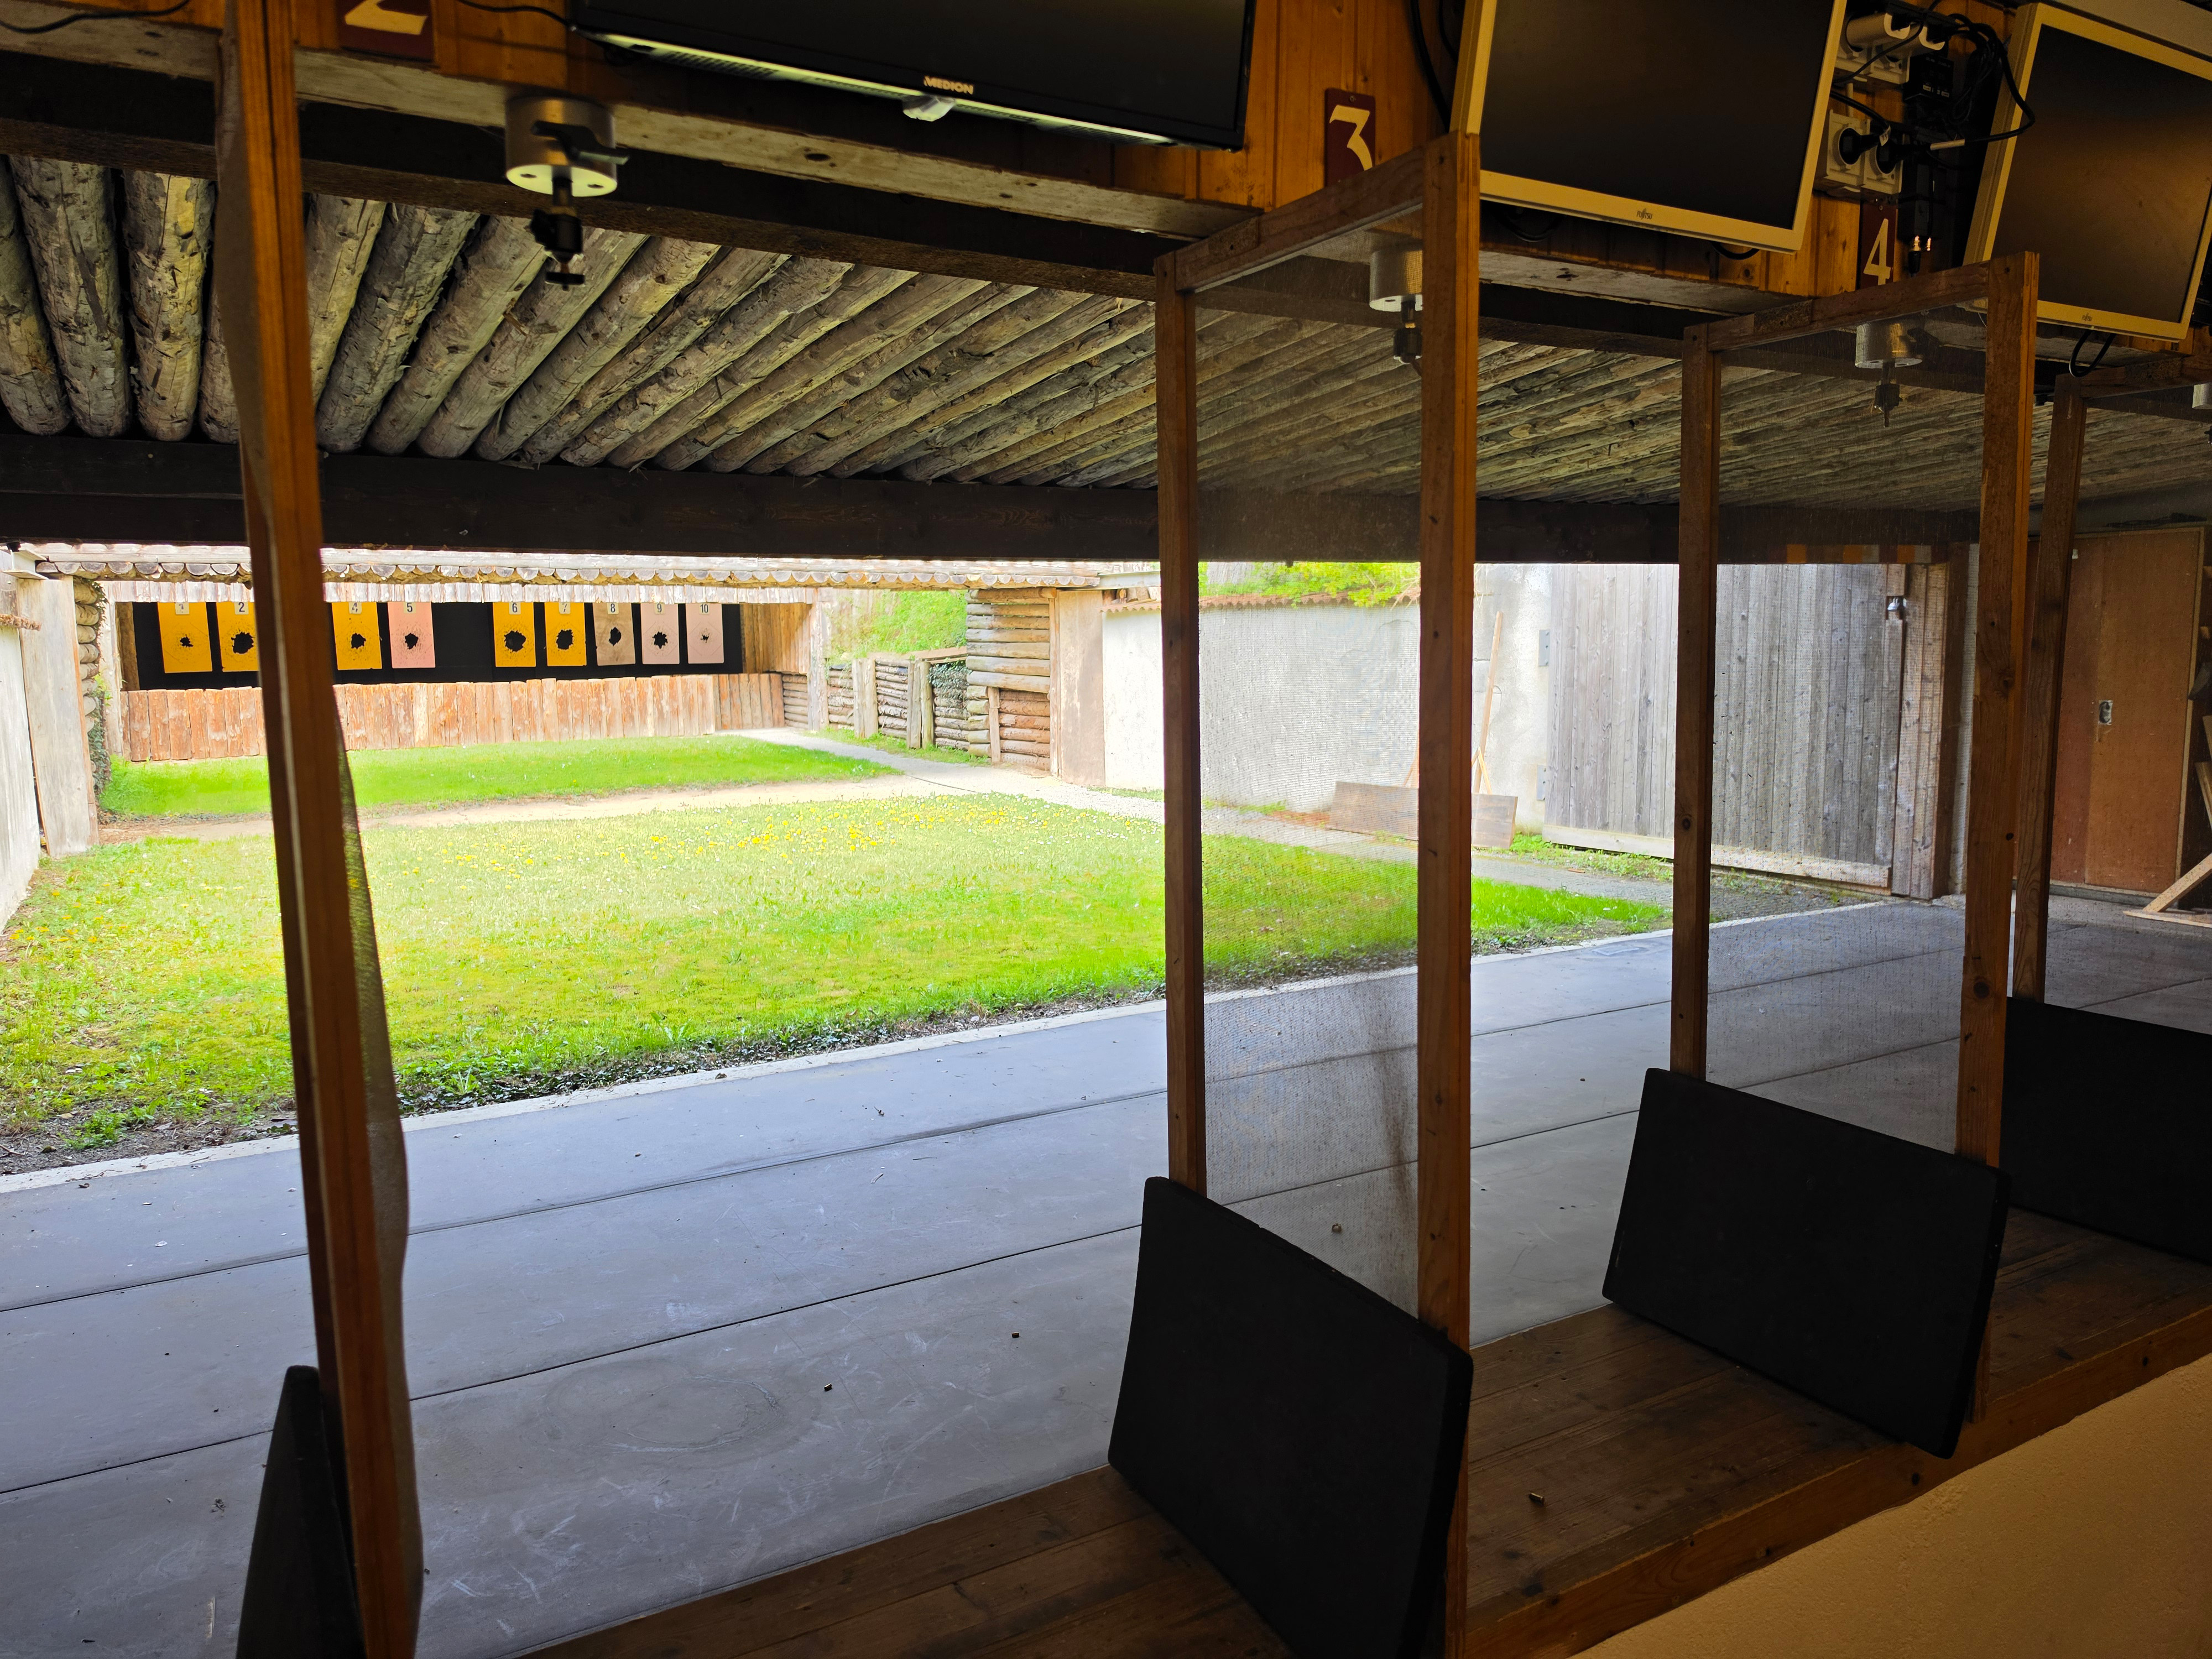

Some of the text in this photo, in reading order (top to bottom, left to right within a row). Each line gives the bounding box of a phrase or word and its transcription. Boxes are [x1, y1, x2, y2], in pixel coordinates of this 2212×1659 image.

[924, 76, 974, 95] MEDION
[1329, 105, 1373, 171] 3
[1636, 208, 1653, 220] FUJITSU
[1863, 218, 1891, 285] 4
[238, 602, 245, 612] 2
[406, 602, 413, 612] 5
[512, 603, 518, 613] 6
[610, 603, 615, 613] 8
[656, 603, 662, 613] 9
[700, 603, 708, 613] 10
